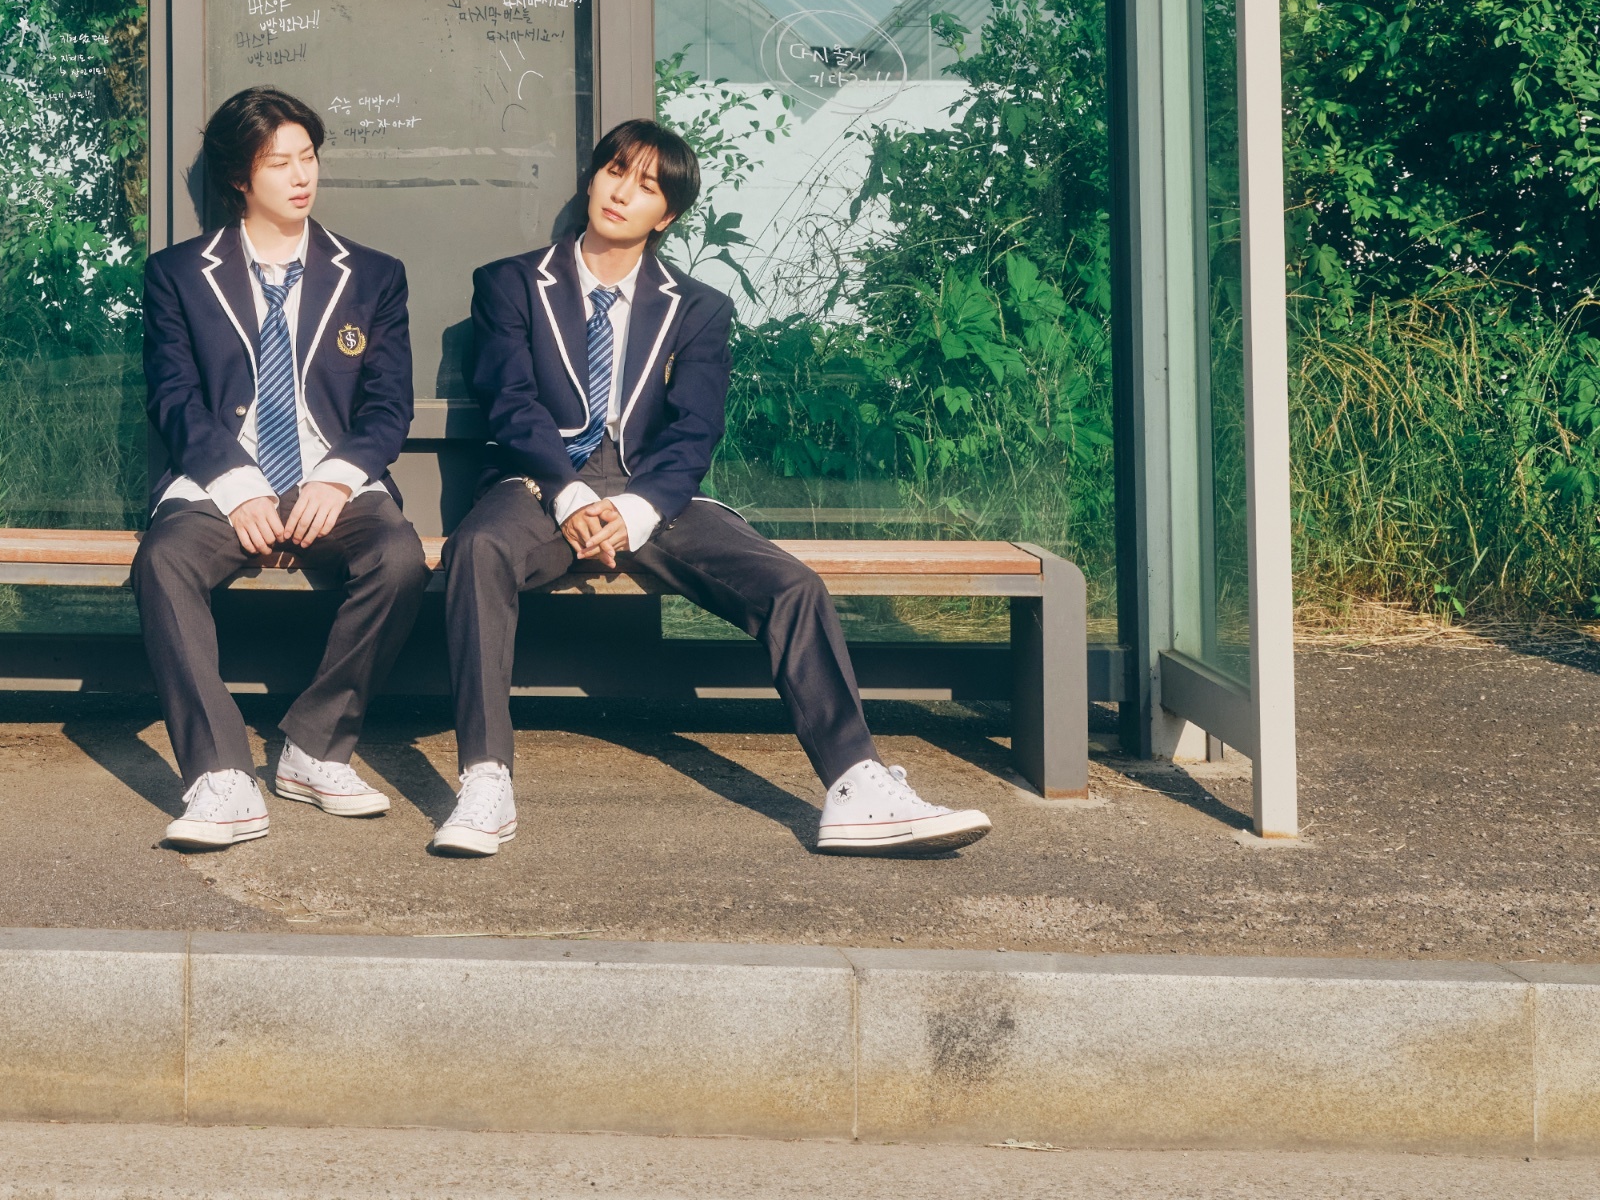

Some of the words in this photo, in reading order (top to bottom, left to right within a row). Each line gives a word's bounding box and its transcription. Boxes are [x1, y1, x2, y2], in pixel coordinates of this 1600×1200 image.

[789, 43, 829, 63] 다시
[833, 43, 866, 66] 올게
[327, 96, 352, 115] 수능
